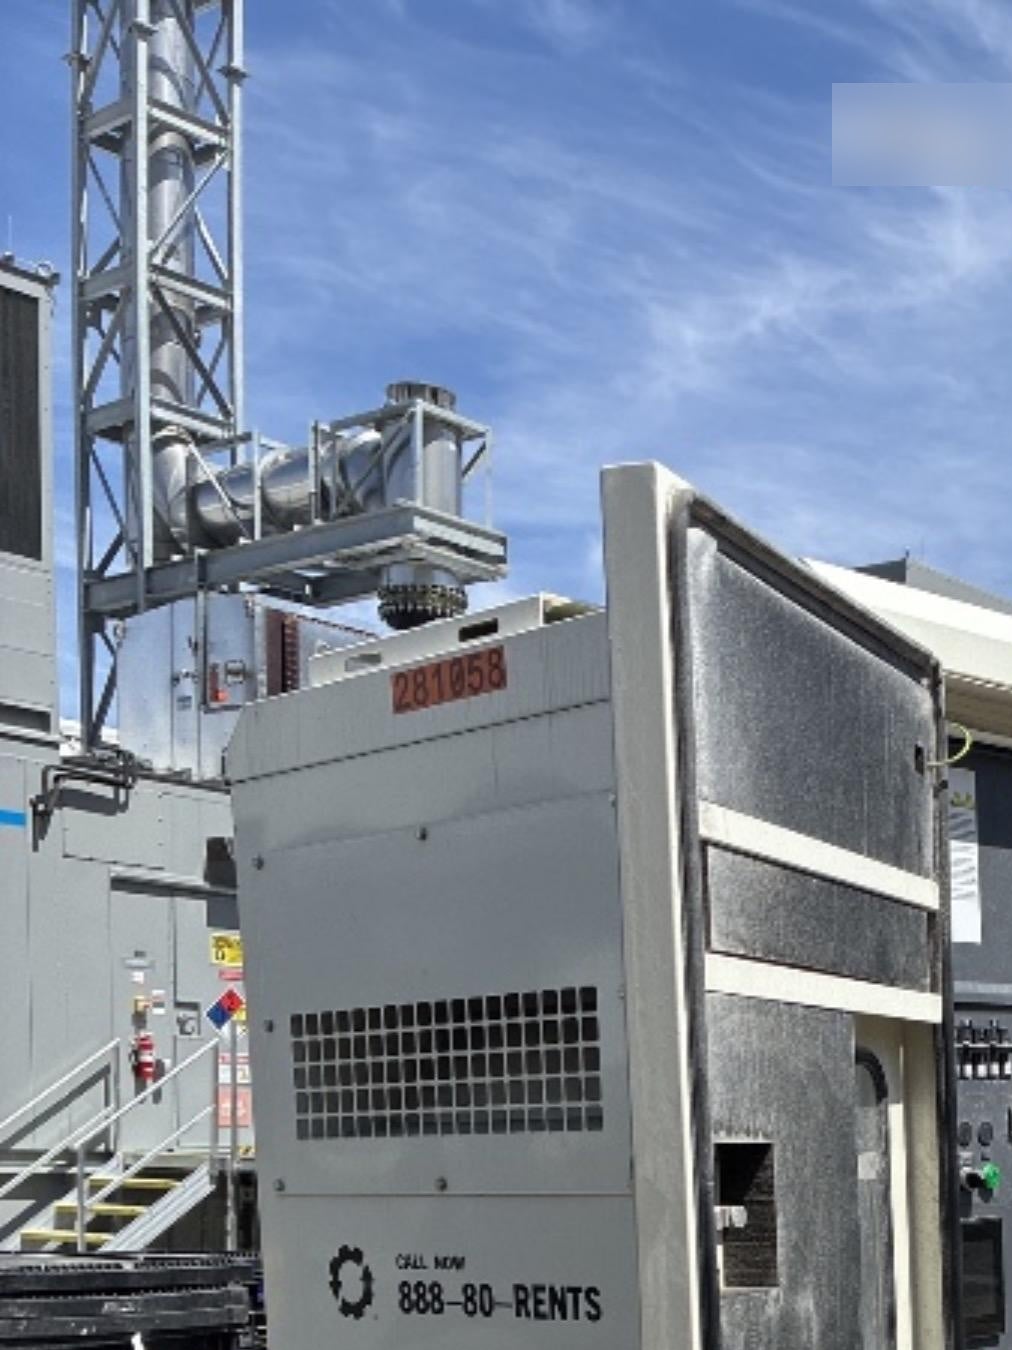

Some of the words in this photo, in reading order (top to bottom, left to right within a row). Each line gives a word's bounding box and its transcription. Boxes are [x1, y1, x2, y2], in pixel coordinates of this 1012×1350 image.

[395, 648, 501, 710] 281058
[395, 1254, 427, 1270] CALL
[434, 1255, 466, 1271] NOW
[398, 1280, 603, 1322] 888-80-RENTS
